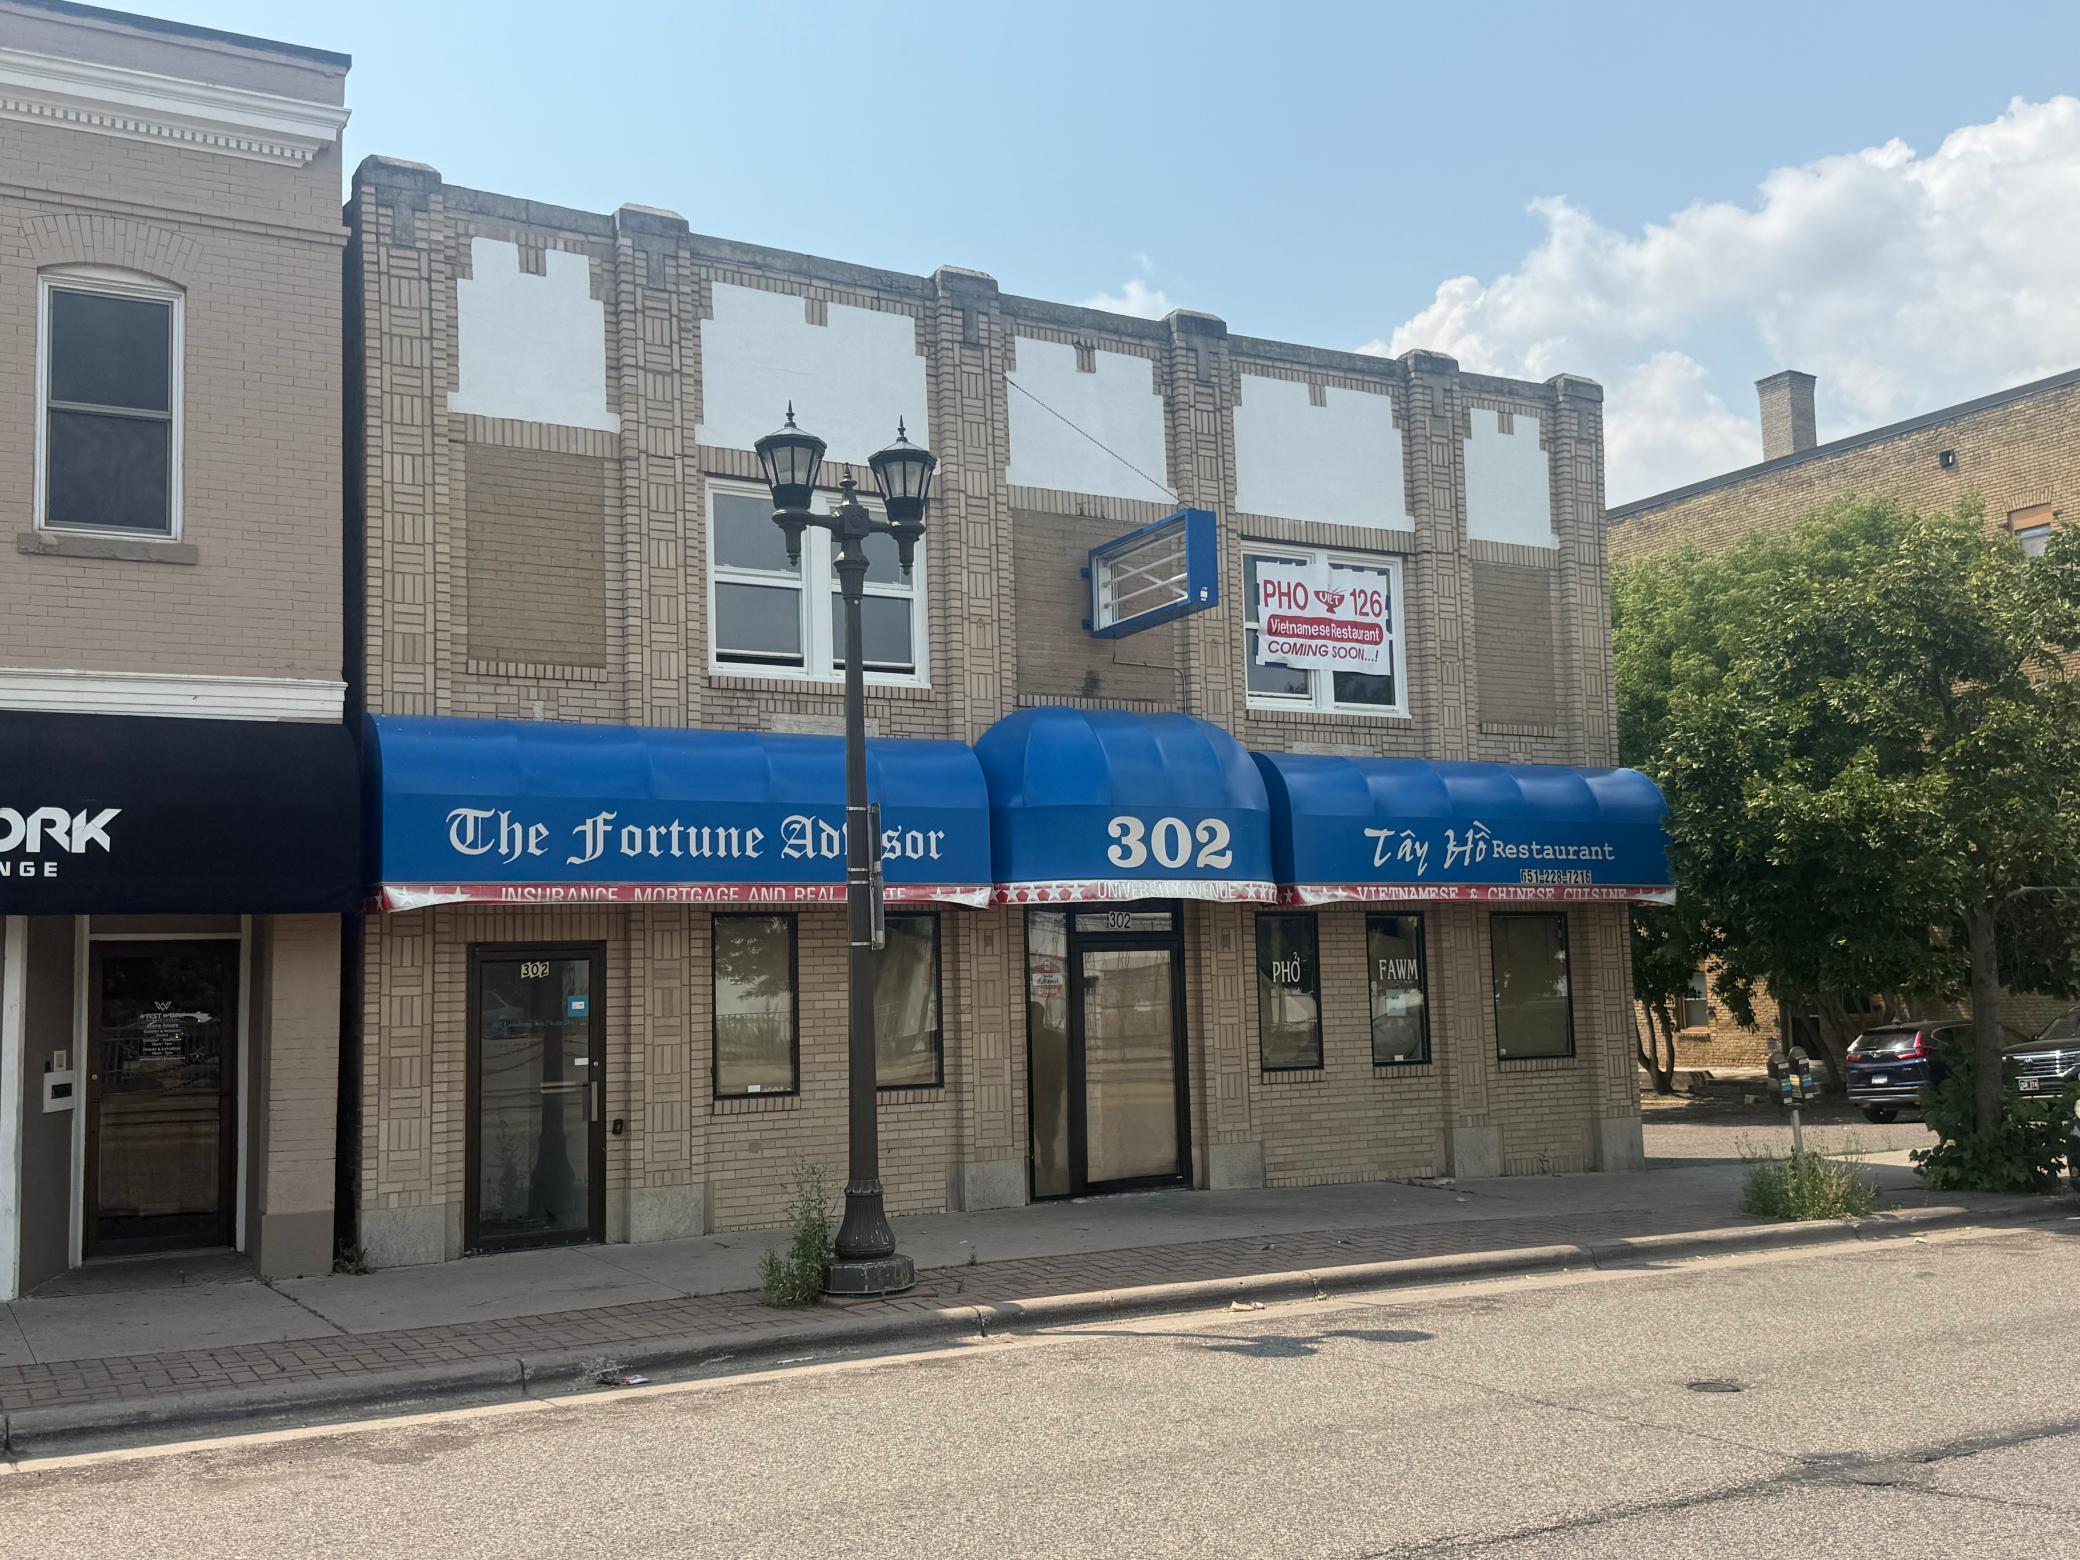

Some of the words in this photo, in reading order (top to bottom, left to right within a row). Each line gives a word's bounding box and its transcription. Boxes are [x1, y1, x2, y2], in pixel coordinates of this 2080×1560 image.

[1263, 579, 1309, 611] PHO
[1350, 588, 1383, 618] 126
[1318, 592, 1341, 606] VIET
[1270, 617, 1330, 636] Vietnamese
[1331, 623, 1380, 642] Restaurant
[1268, 640, 1329, 658] COMING
[446, 807, 550, 865] The
[566, 811, 765, 865] Fortune
[781, 815, 945, 860] Adsor
[1107, 816, 1232, 869] 302
[1363, 827, 1429, 877] Tây
[1492, 839, 1615, 861] Restaurant
[501, 887, 618, 902] INSURANCE
[633, 887, 739, 902] MORTGAGE
[750, 887, 786, 901] AND
[1097, 882, 1180, 899] UNIVERSITY
[1186, 882, 1237, 899] AVENUE
[1356, 887, 1458, 900] VIETNAMESE
[1487, 887, 1555, 900] CHINESE
[1564, 887, 1628, 900] CUISINE
[1109, 912, 1131, 929] 302
[522, 963, 548, 976] 302
[1378, 959, 1419, 980] FAWM
